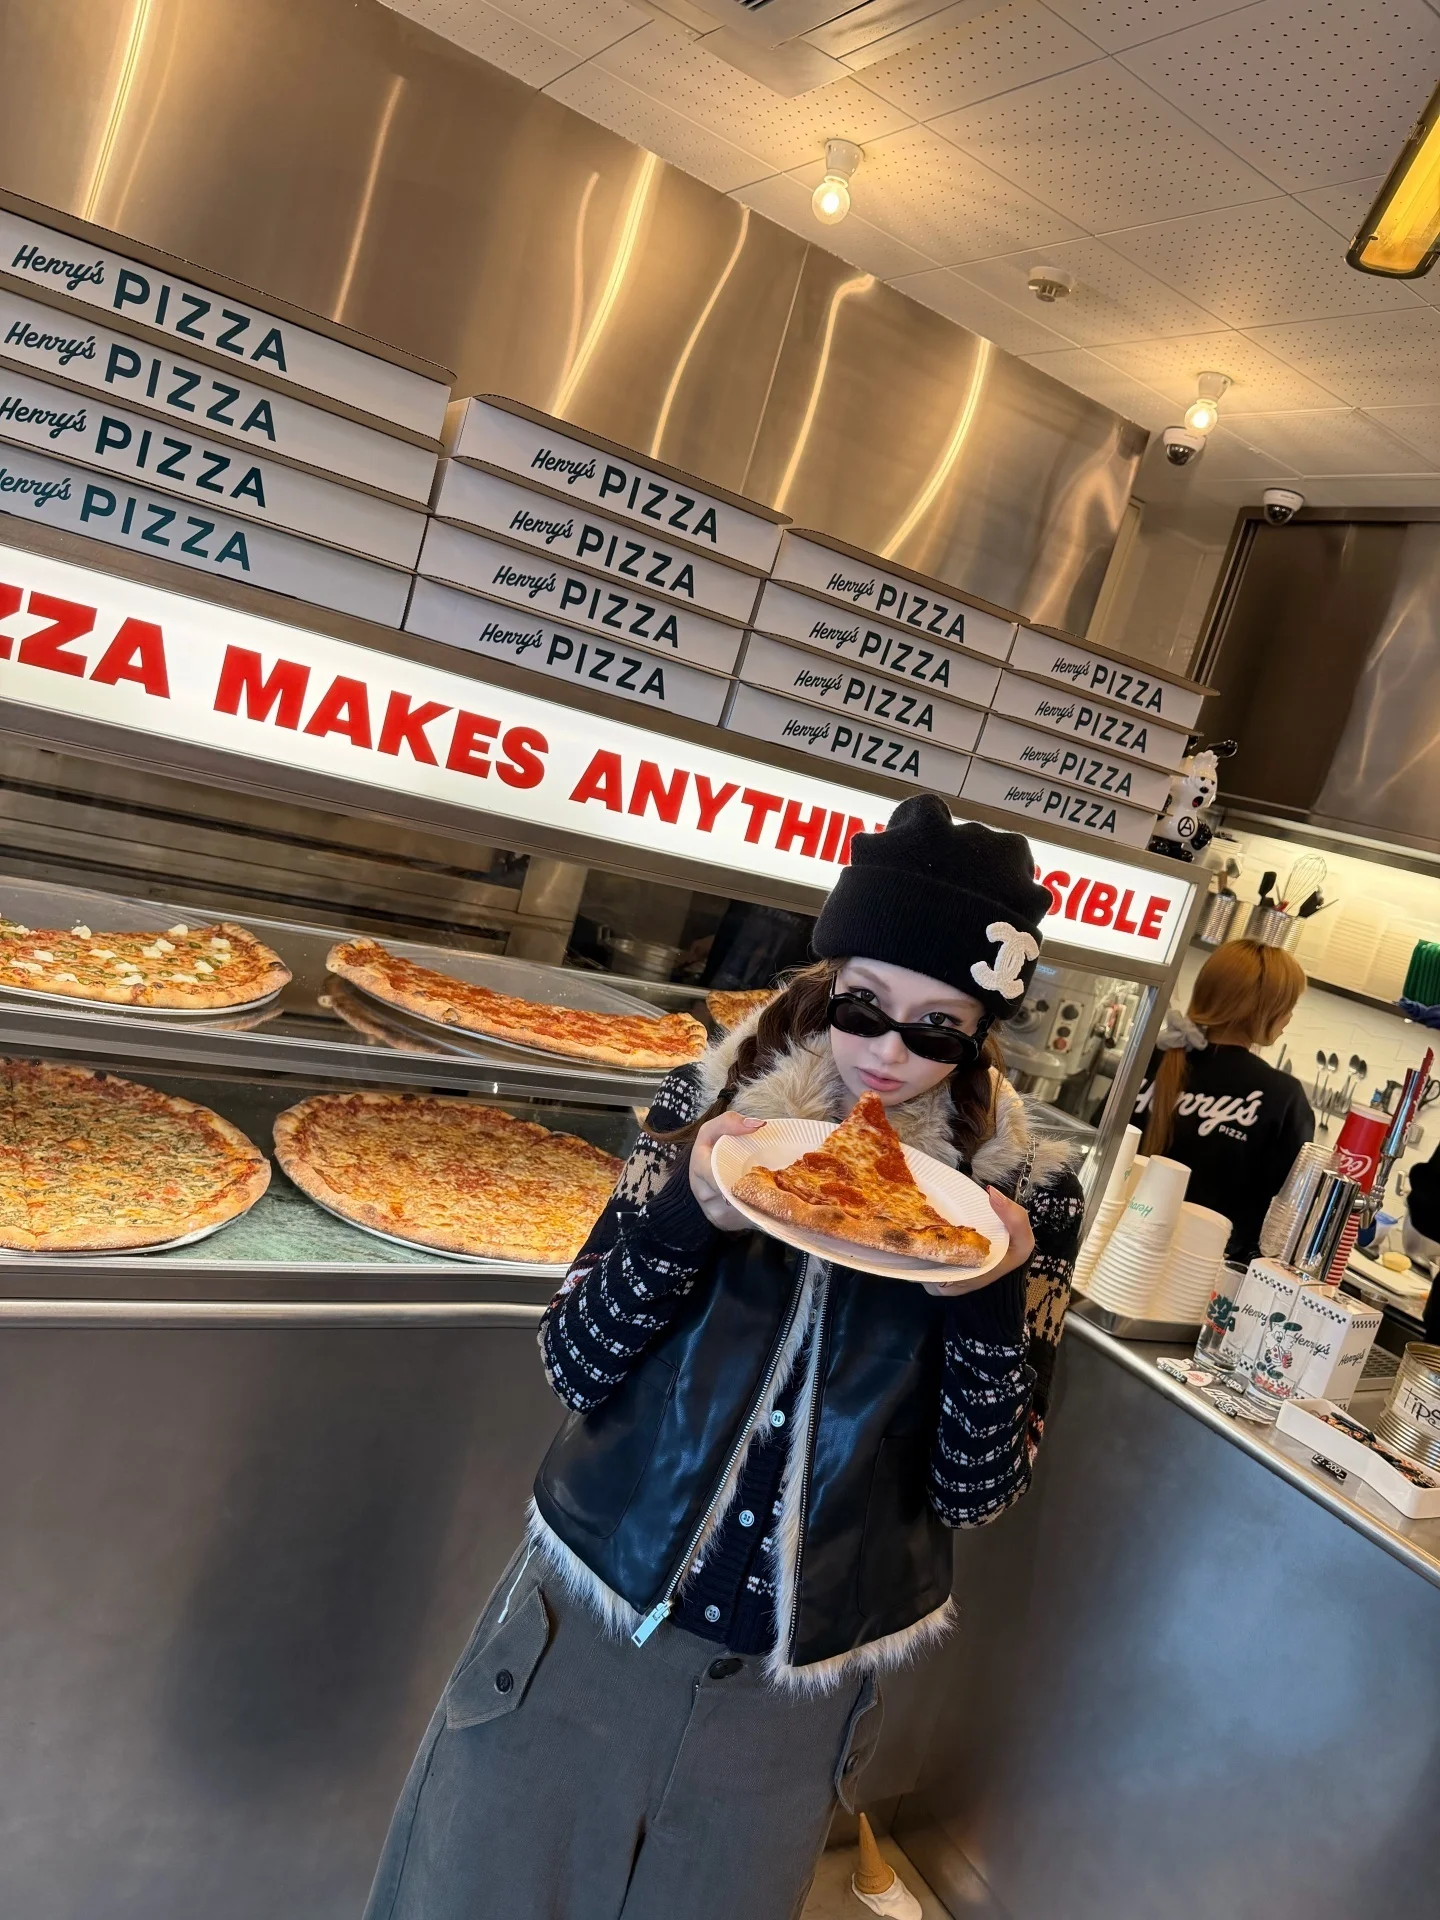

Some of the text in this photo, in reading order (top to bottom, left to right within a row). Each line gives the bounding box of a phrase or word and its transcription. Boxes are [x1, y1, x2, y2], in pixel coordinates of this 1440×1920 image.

[11, 245, 287, 372] Henry's PIZZA
[4, 322, 276, 442] Henry's PIZZA
[0, 397, 265, 508] Henry's PIZZA
[80, 484, 250, 571] PIZZA
[531, 449, 716, 543] Henry's PIZZA
[509, 511, 694, 598] Henry's PIZZA
[492, 566, 678, 648] Henry's PIZZA
[826, 573, 964, 643] Henry's PIZZA
[479, 623, 664, 700] Henry's PIZZA
[809, 622, 949, 687] Henry's PIZZA
[1051, 658, 1163, 713] Henry's PIZZA
[213, 644, 549, 789] MAKES
[794, 670, 933, 732] Henry's PIZZA
[1035, 701, 1147, 753] Henry's PIZZA
[782, 720, 919, 777] Henry's PIZZA
[1020, 746, 1132, 796] Henry's PIZZA
[1004, 787, 1116, 833] Henry's PIZZA
[1218, 1124, 1248, 1142] PIZZA
